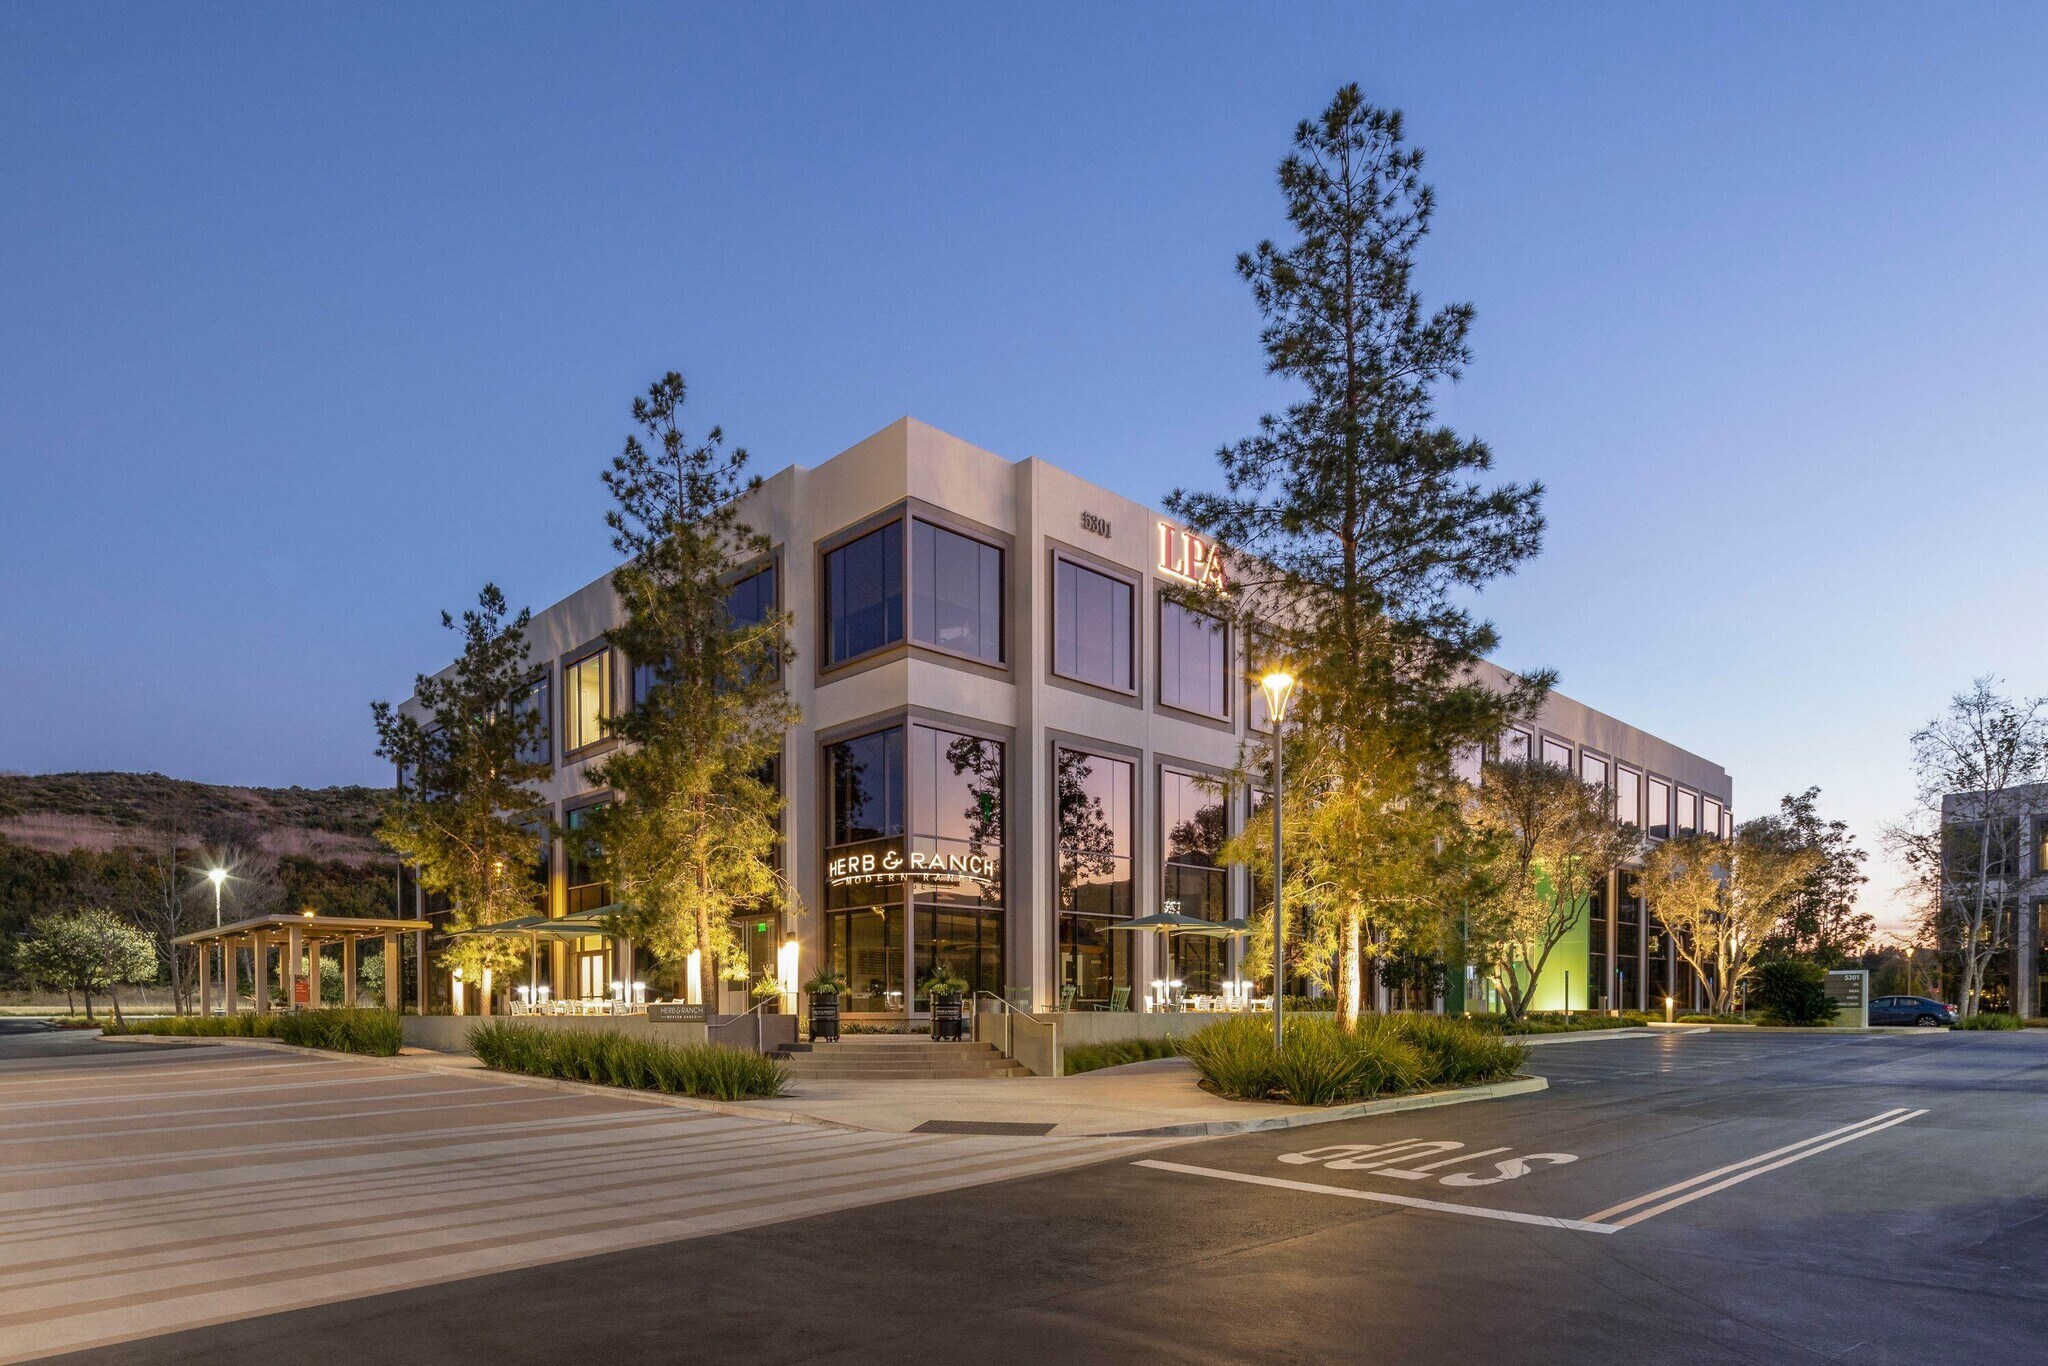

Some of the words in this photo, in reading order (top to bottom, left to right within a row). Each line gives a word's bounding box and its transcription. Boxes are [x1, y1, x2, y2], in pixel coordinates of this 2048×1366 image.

[1081, 511, 1112, 538] 5301
[1157, 521, 1233, 598] LPA
[829, 854, 875, 878] HERB
[882, 850, 904, 870] &
[910, 851, 994, 877] RANCH
[845, 872, 908, 886] MODERN
[922, 872, 975, 885] RANGE
[1277, 1138, 1580, 1187] STOP
